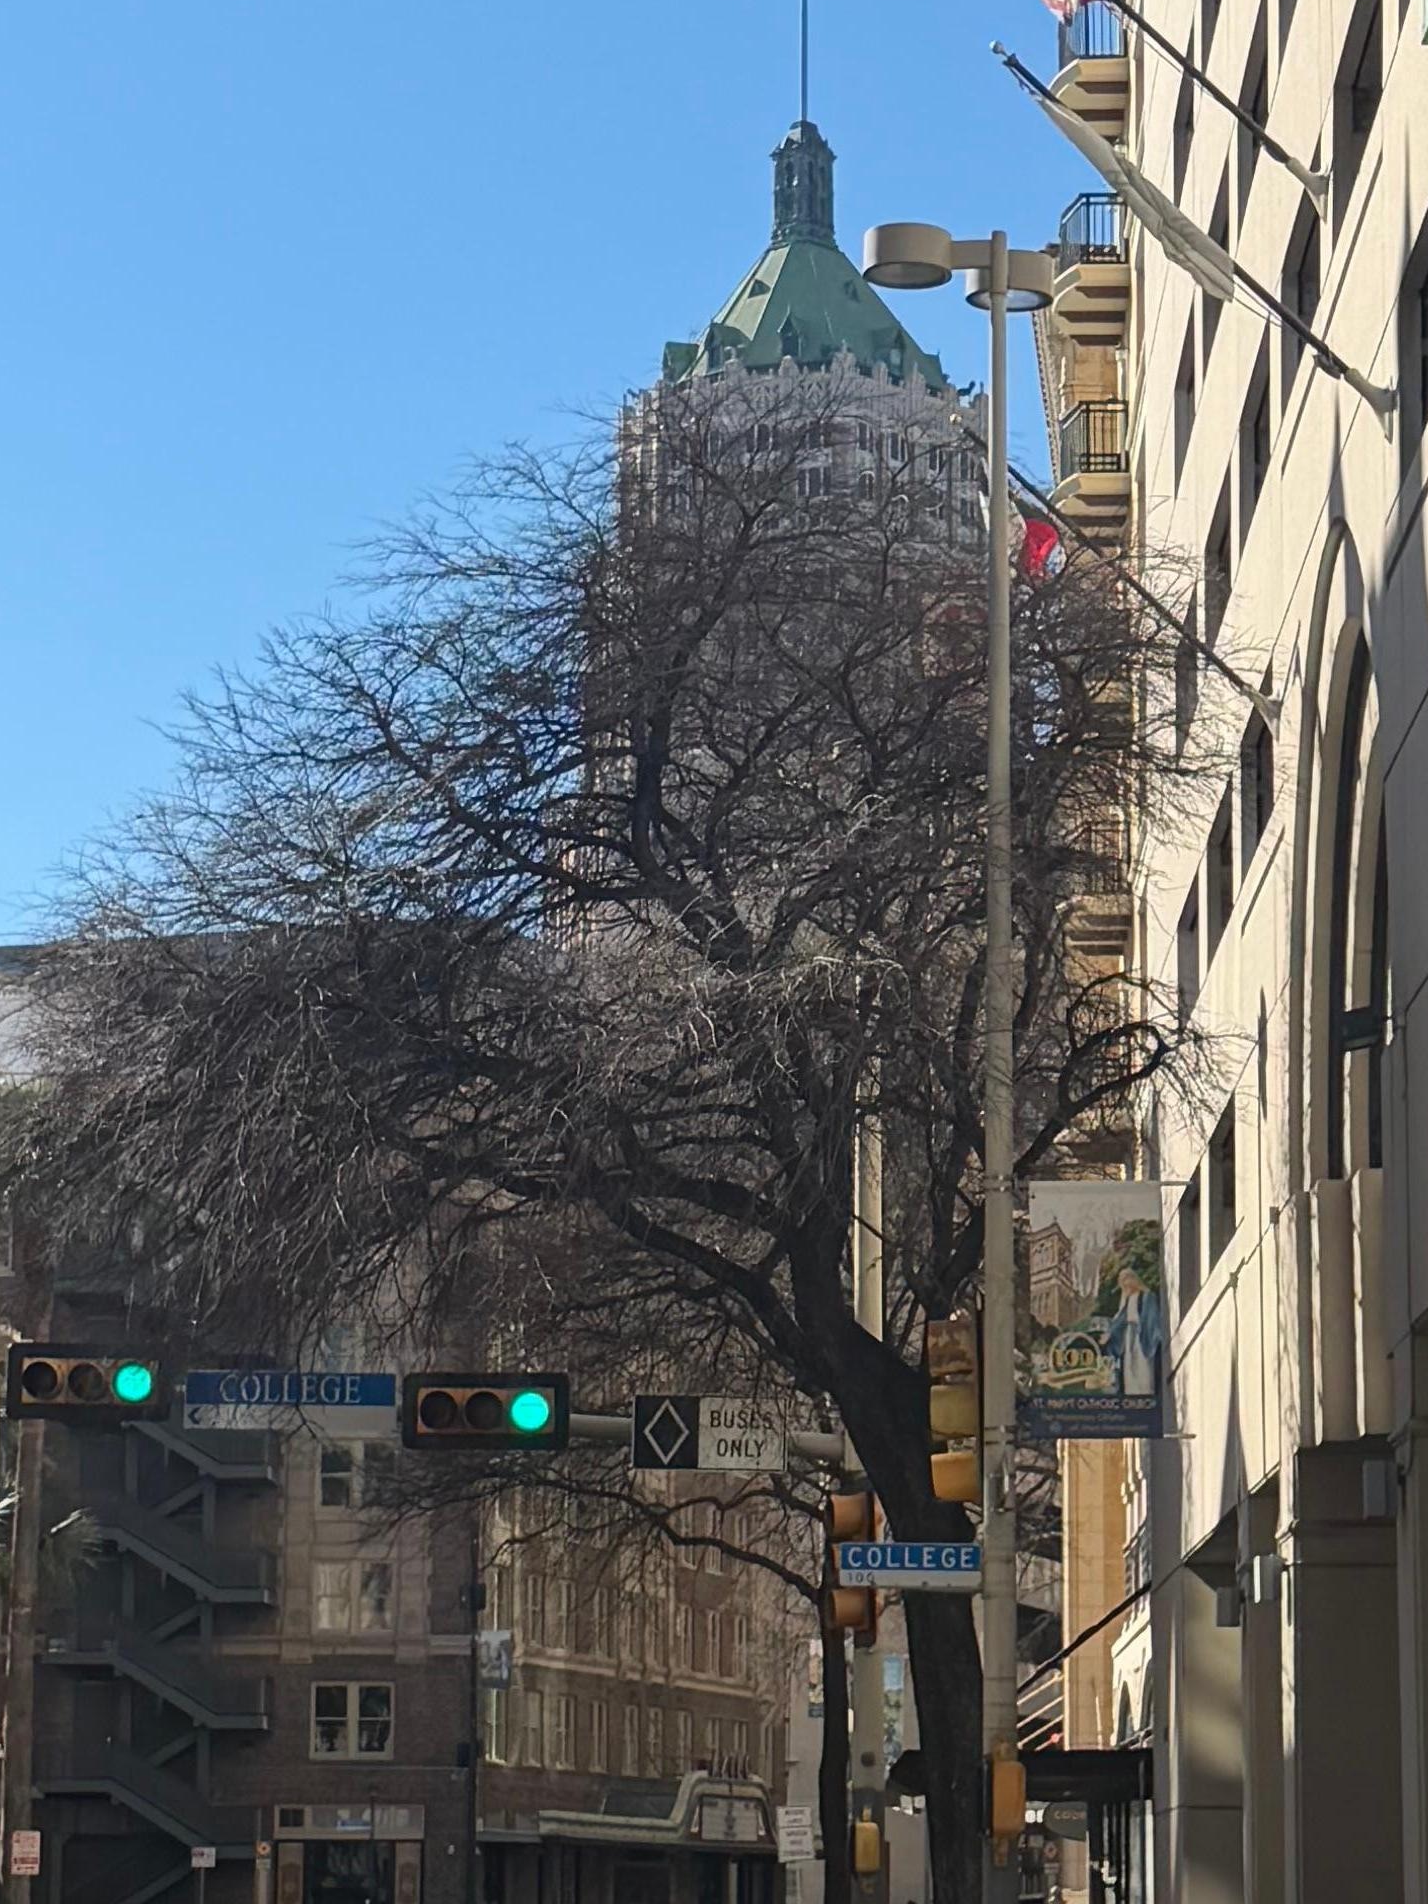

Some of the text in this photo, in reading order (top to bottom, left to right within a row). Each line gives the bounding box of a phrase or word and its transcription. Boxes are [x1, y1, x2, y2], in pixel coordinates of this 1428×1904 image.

[219, 1374, 361, 1404] COLLEGE
[710, 1410, 773, 1430] BUSES
[716, 1438, 765, 1458] ONLY
[848, 1547, 974, 1569] COLLEGE
